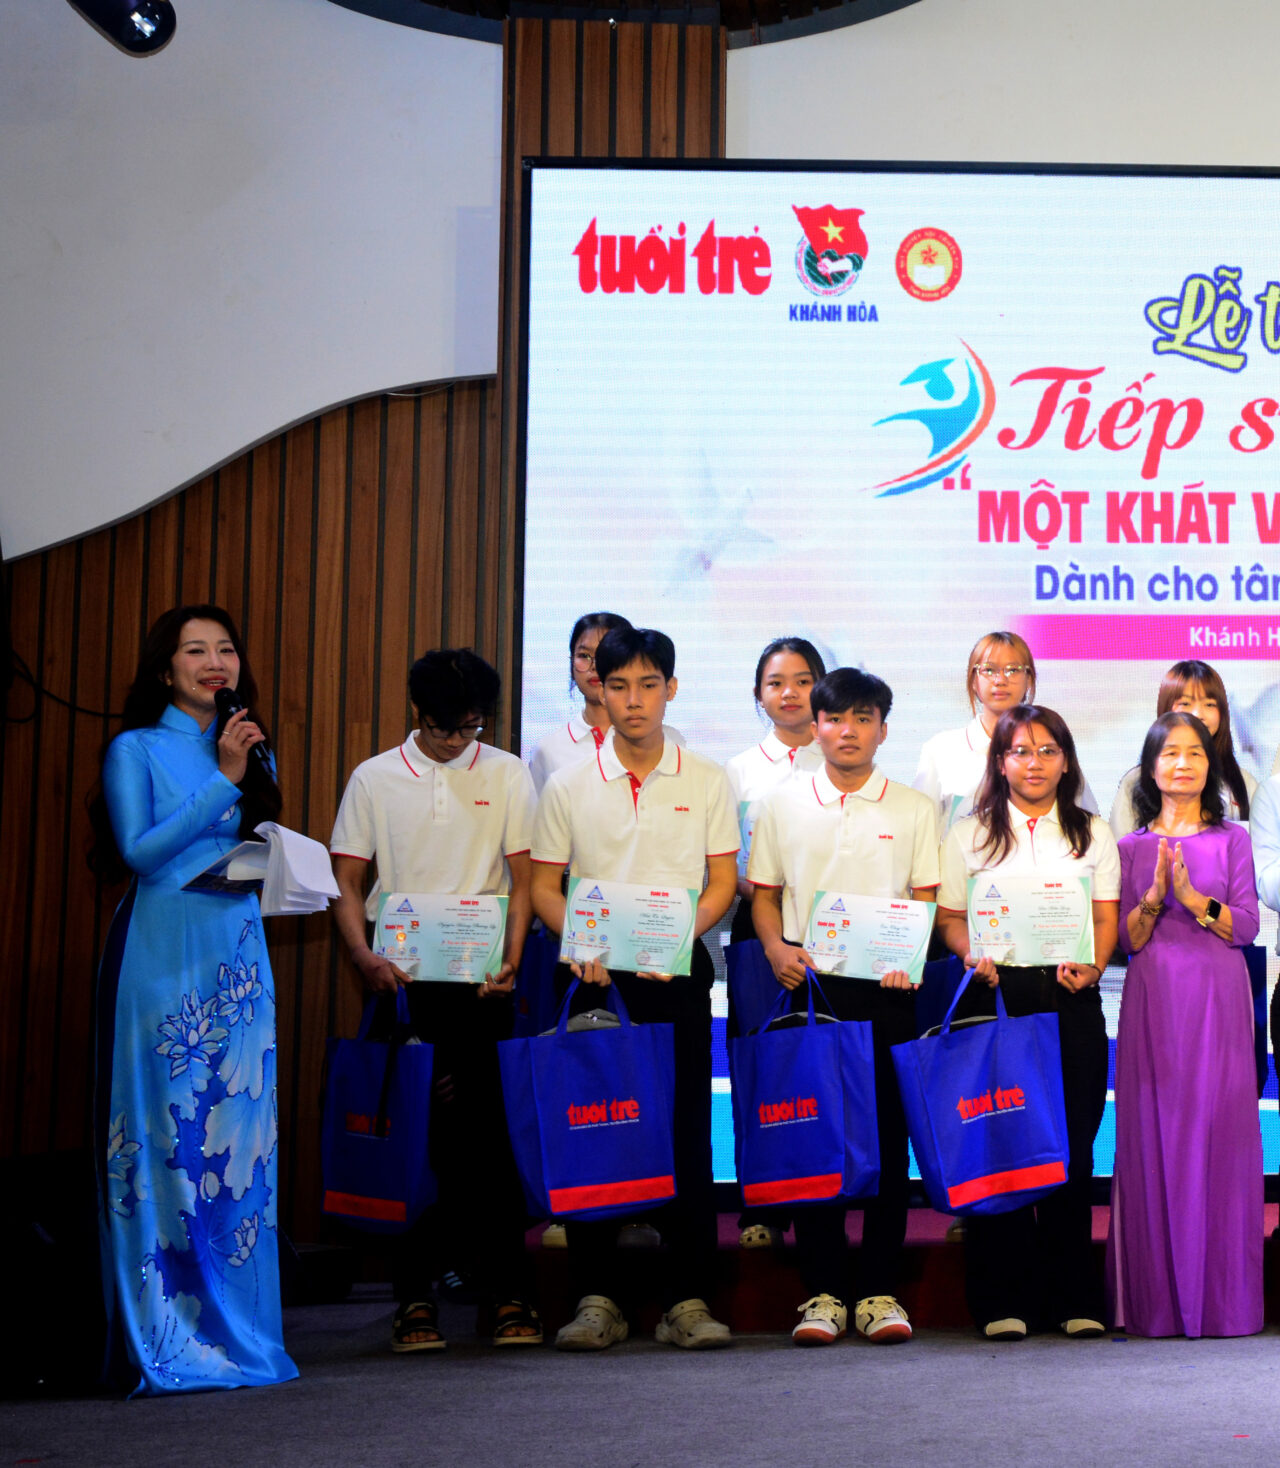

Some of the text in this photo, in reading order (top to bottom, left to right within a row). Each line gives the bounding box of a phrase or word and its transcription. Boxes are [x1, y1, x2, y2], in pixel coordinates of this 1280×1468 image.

[573, 216, 686, 295] tuổi
[691, 217, 772, 295] trẻ
[789, 301, 879, 322] KHÁNH HÒA
[1145, 265, 1252, 373] Lễ
[996, 366, 1205, 480] Tiếp
[1105, 481, 1237, 545] KHÁT
[1035, 560, 1135, 602] Dành
[1148, 565, 1220, 602] cho
[1189, 627, 1261, 648] Khánh
